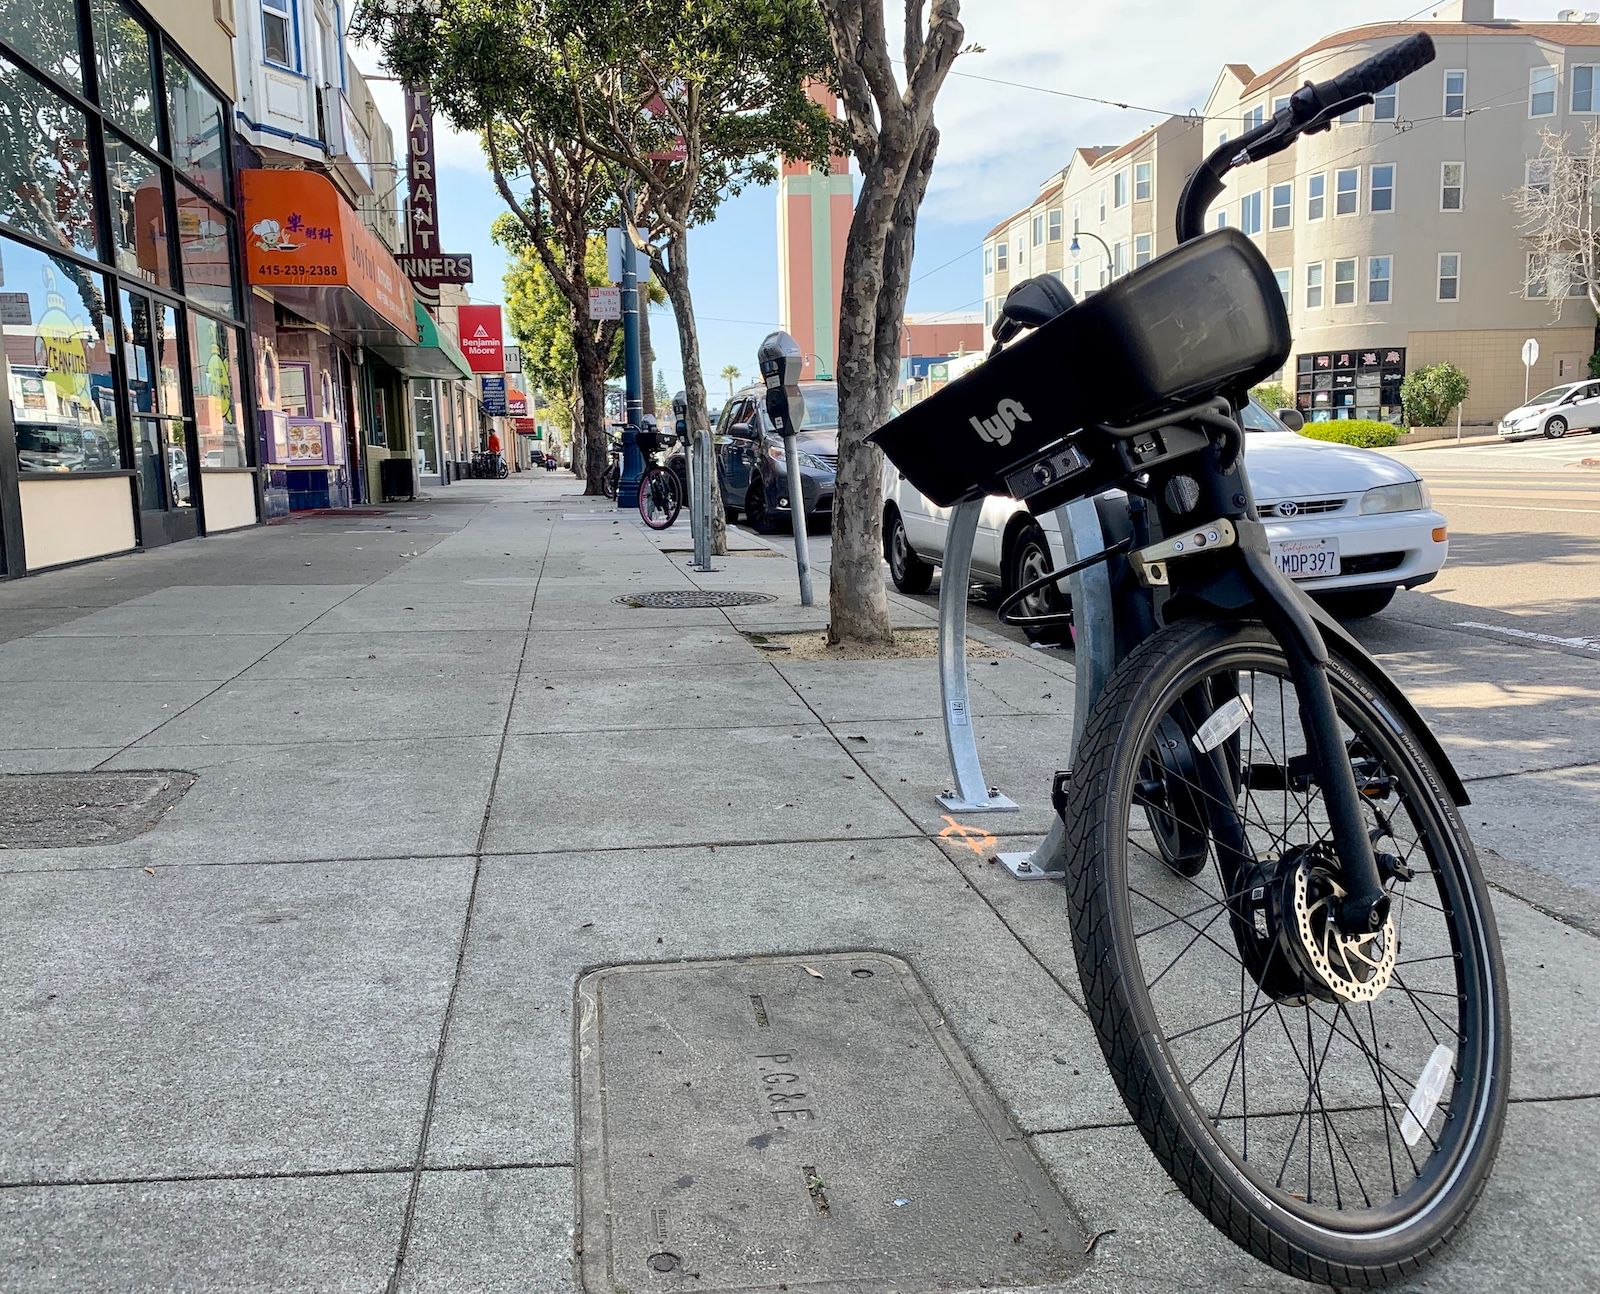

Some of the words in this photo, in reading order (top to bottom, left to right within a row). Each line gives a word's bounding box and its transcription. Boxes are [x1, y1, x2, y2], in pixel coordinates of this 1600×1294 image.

[409, 90, 435, 250] TAURANT
[258, 265, 338, 276] 415-239-2388
[397, 257, 471, 278] INNERS
[462, 338, 501, 347] Benjamin
[468, 346, 496, 355] Moore
[968, 397, 1033, 447] lyft
[1281, 542, 1325, 553] California
[1325, 658, 1373, 701] SCHWALBE
[1401, 733, 1440, 794] MARATHON
[1438, 796, 1458, 829] PLUS
